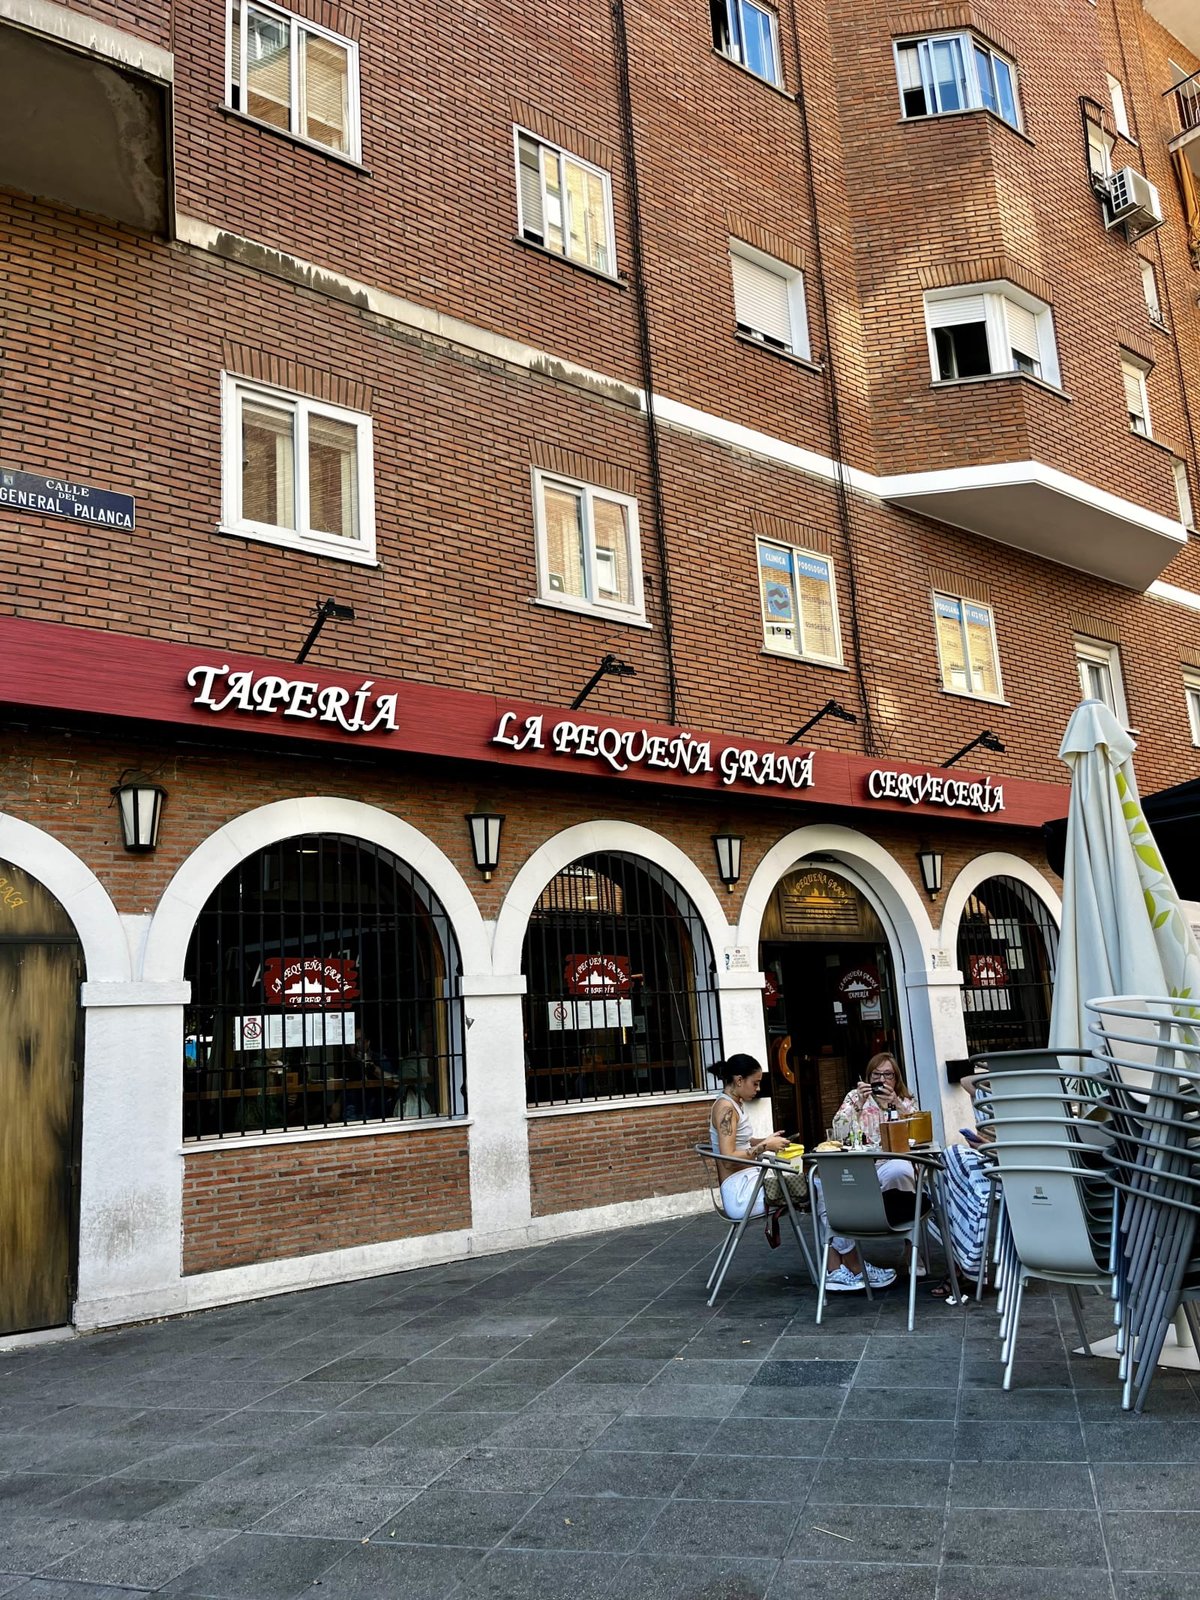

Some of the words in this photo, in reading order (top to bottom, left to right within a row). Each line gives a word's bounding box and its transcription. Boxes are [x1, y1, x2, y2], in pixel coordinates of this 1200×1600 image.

[0, 487, 63, 513] GENERAL
[74, 502, 132, 528] PALANCA
[45, 480, 90, 498] CALLE
[58, 491, 78, 502] DEL
[187, 664, 400, 732] TAPERÍA
[493, 711, 545, 750] LA
[552, 720, 714, 775] PEQUEÑA
[720, 747, 816, 788] GRANÁ
[868, 769, 1006, 813] CERVECERÍA
